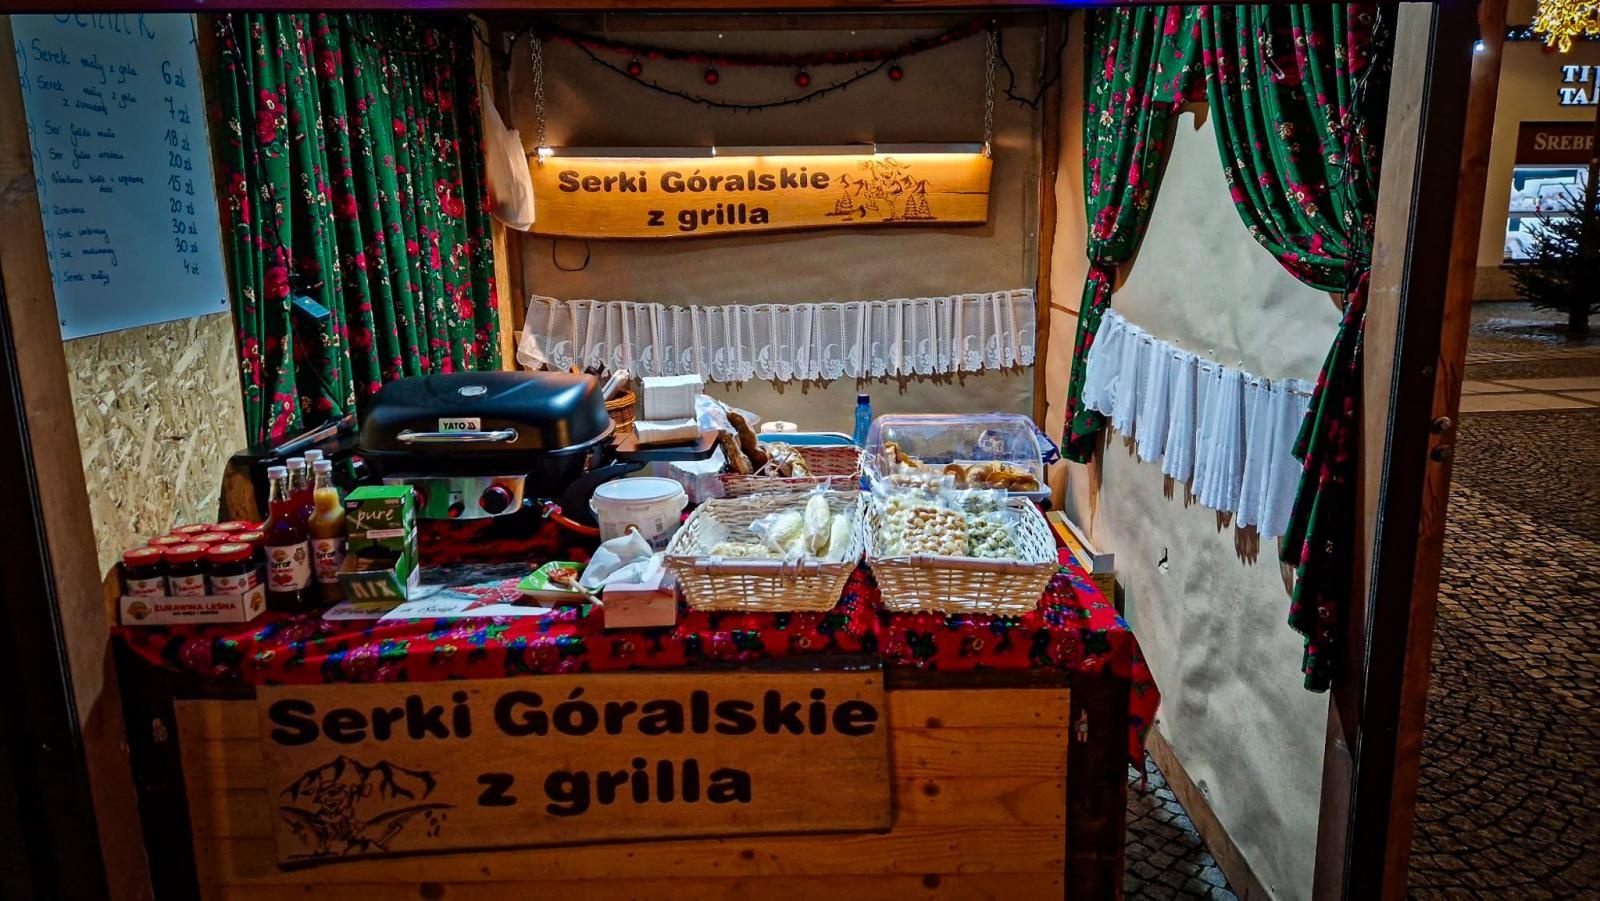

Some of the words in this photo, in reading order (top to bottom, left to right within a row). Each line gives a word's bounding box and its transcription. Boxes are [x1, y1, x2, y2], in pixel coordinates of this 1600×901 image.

[31, 38, 71, 65] Serek
[161, 60, 172, 85] 6
[1562, 65, 1600, 83] TI
[164, 96, 175, 120] 7
[164, 128, 178, 147] 18
[169, 150, 182, 168] 20
[168, 174, 181, 192] 15
[558, 170, 647, 193] Serki
[660, 166, 830, 193] Góralskie
[170, 197, 182, 213] 20
[172, 218, 186, 235] 30
[647, 209, 665, 226] z
[677, 202, 769, 232] grilla
[175, 237, 188, 253] 30
[443, 422, 466, 430] YATO
[356, 508, 395, 530] pure
[267, 691, 473, 747] Serki
[493, 687, 878, 738] Góralskie
[476, 770, 518, 807] z
[544, 757, 752, 817] grilla
